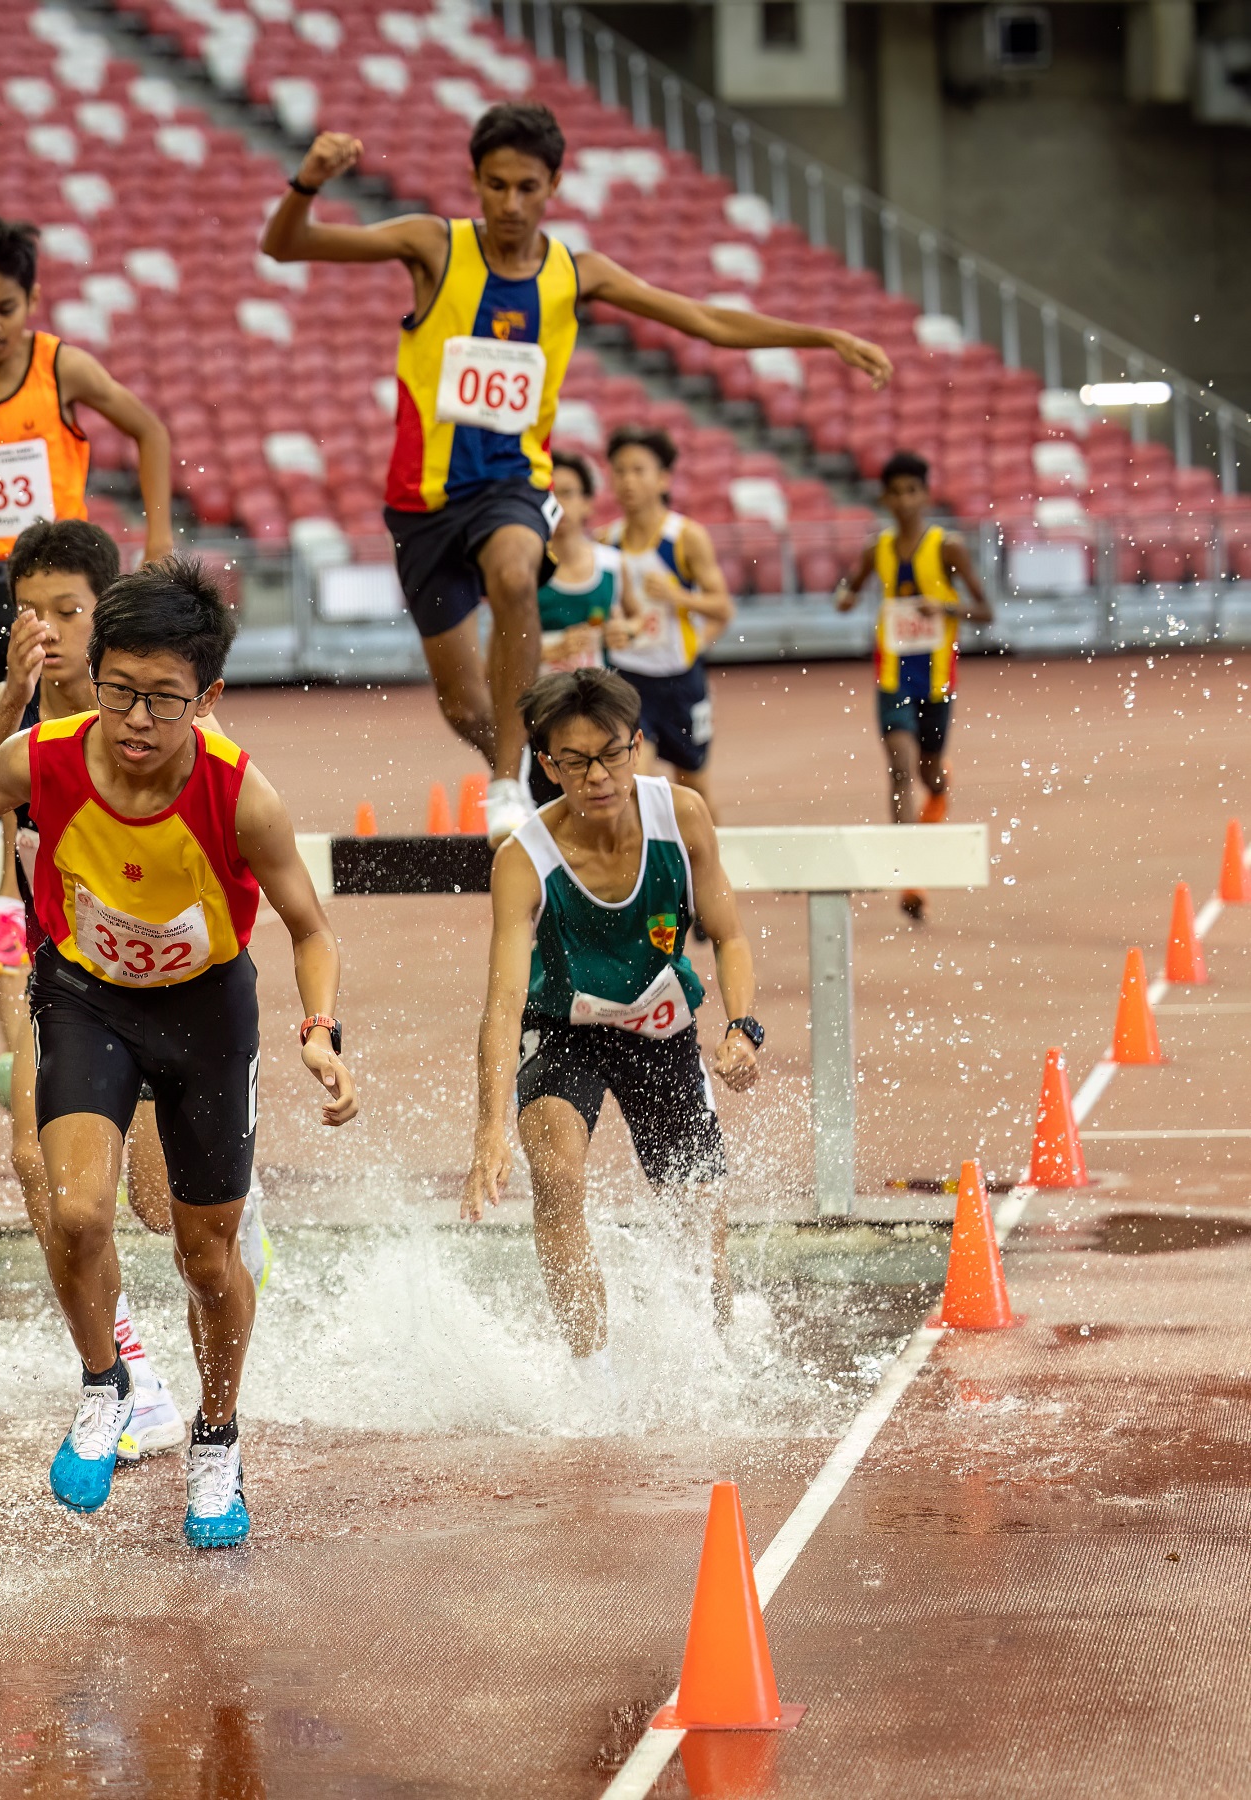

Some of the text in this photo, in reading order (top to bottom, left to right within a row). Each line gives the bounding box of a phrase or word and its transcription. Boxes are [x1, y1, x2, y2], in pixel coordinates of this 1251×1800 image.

[458, 367, 529, 412] 063
[96, 909, 115, 926] TRACK
[121, 925, 140, 934] FIELD
[141, 924, 194, 939] CHAMPIONSHIPS
[101, 909, 187, 935] NATIONAL SCHOOL GAMES
[94, 923, 192, 974] 332
[610, 999, 675, 1031] 79
